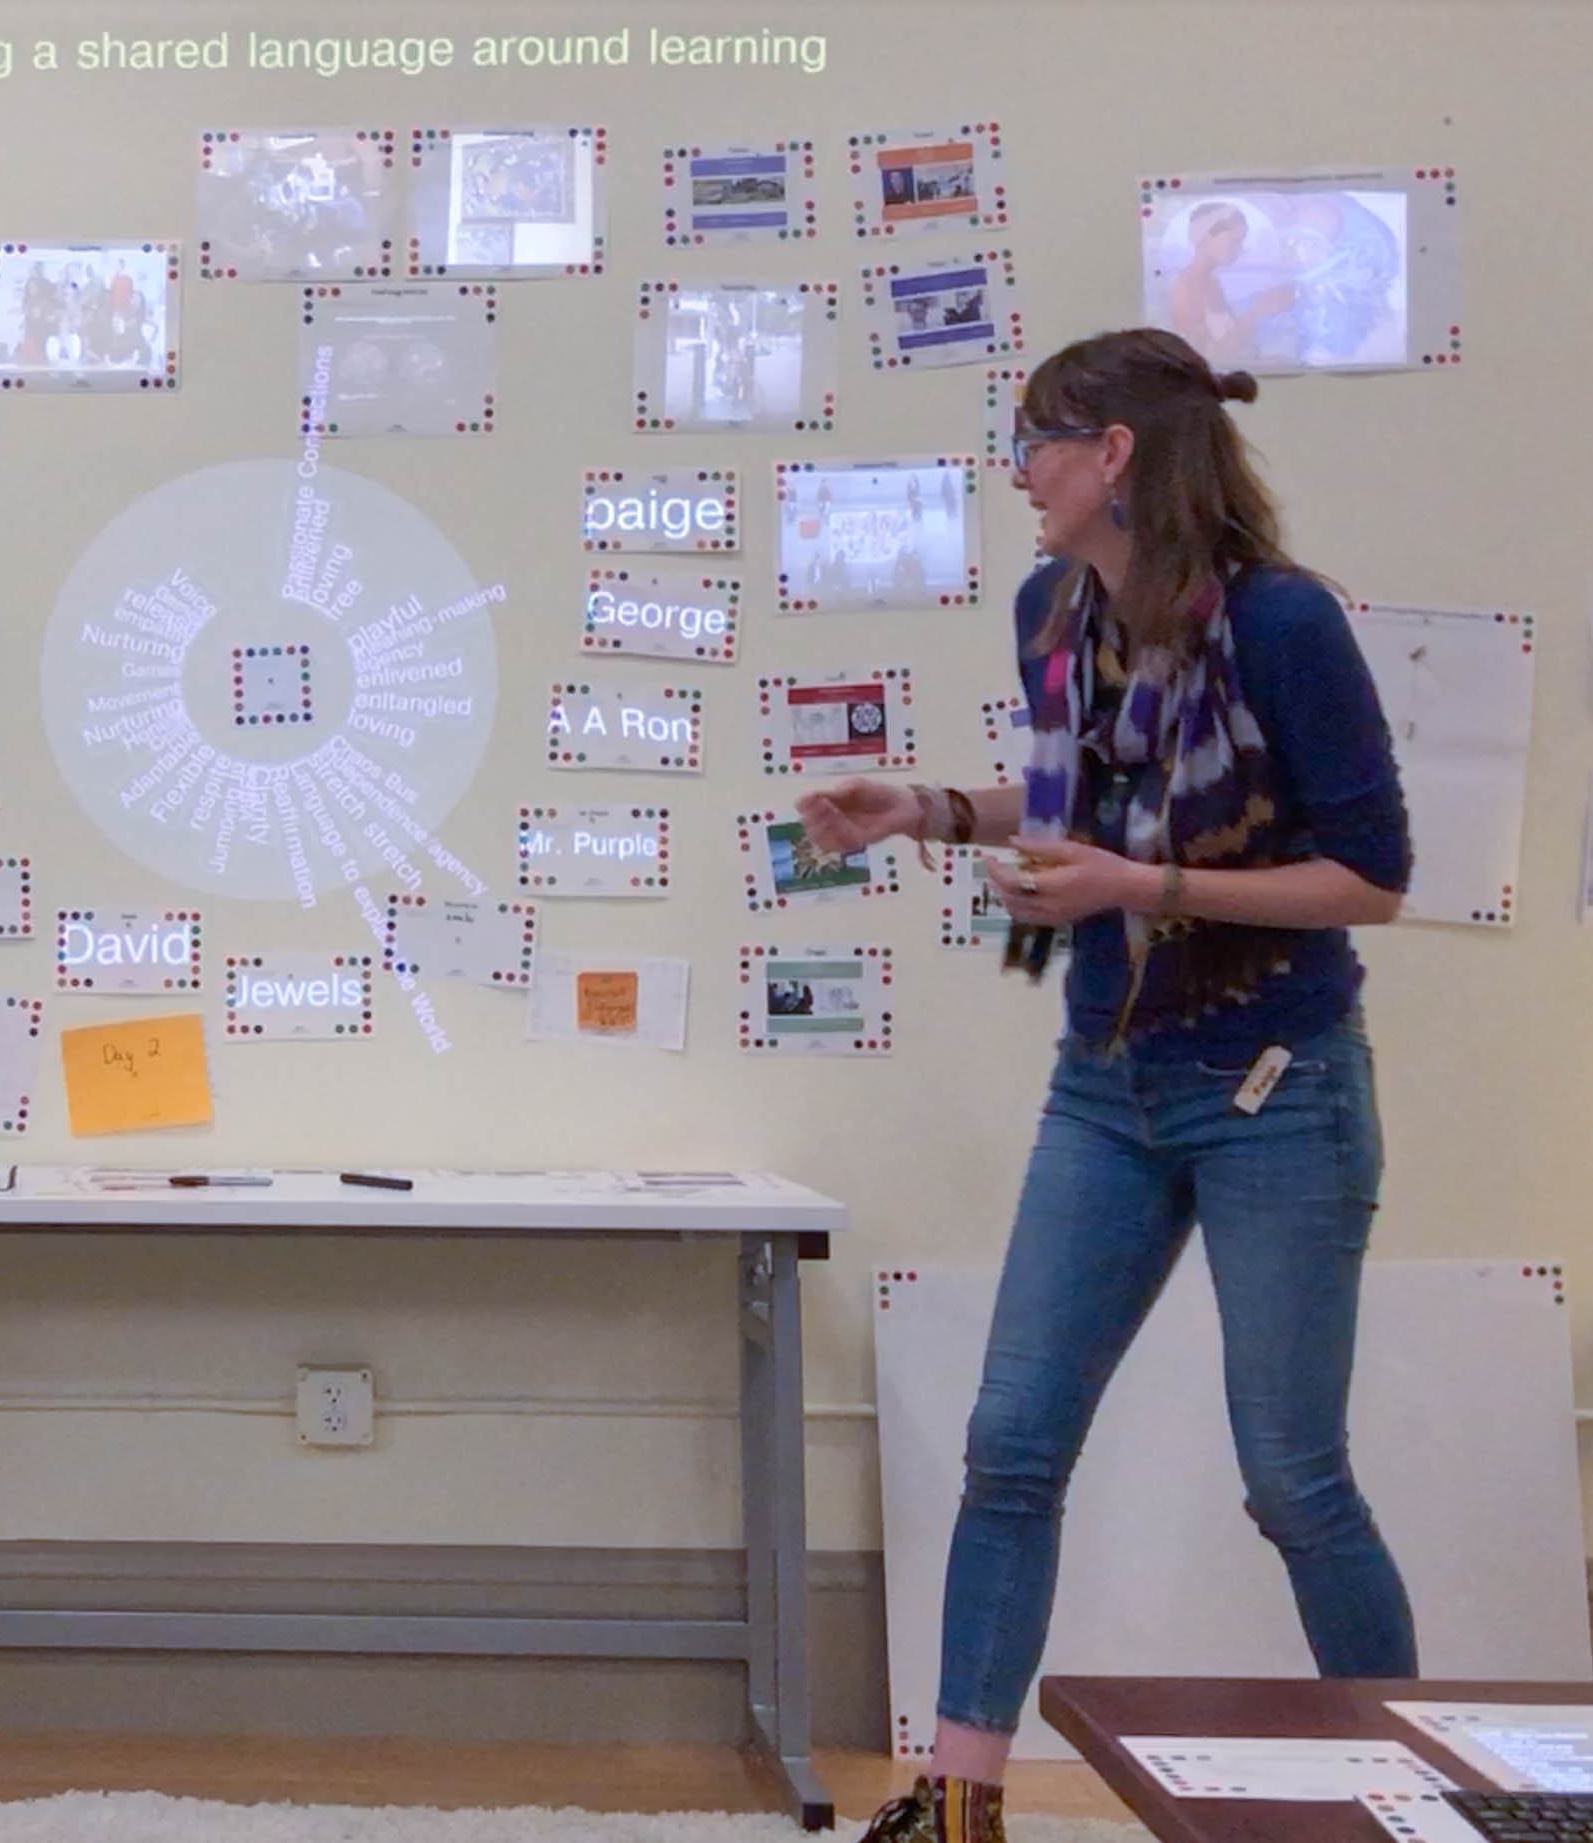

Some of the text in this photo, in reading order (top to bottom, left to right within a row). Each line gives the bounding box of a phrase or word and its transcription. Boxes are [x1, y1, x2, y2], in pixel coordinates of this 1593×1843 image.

[33, 38, 58, 69] a
[77, 31, 228, 69] shared
[249, 31, 454, 76] language
[472, 29, 629, 66] around
[650, 28, 827, 73] learning
[348, 593, 423, 656] playful
[588, 591, 726, 639] George
[80, 622, 185, 664] Nurturing
[357, 657, 462, 689] enlivened
[348, 707, 415, 747] loving
[547, 704, 694, 742] A A Ron
[150, 744, 216, 824] Flexible
[190, 755, 232, 832] respite
[364, 821, 422, 890] stretch
[519, 830, 657, 861] Mr. Purple
[290, 759, 345, 857] Language
[341, 859, 360, 882] to
[411, 991, 453, 1053] World
[62, 923, 191, 965] David
[228, 973, 363, 1008] Jewels
[102, 1038, 160, 1076] Day 2
